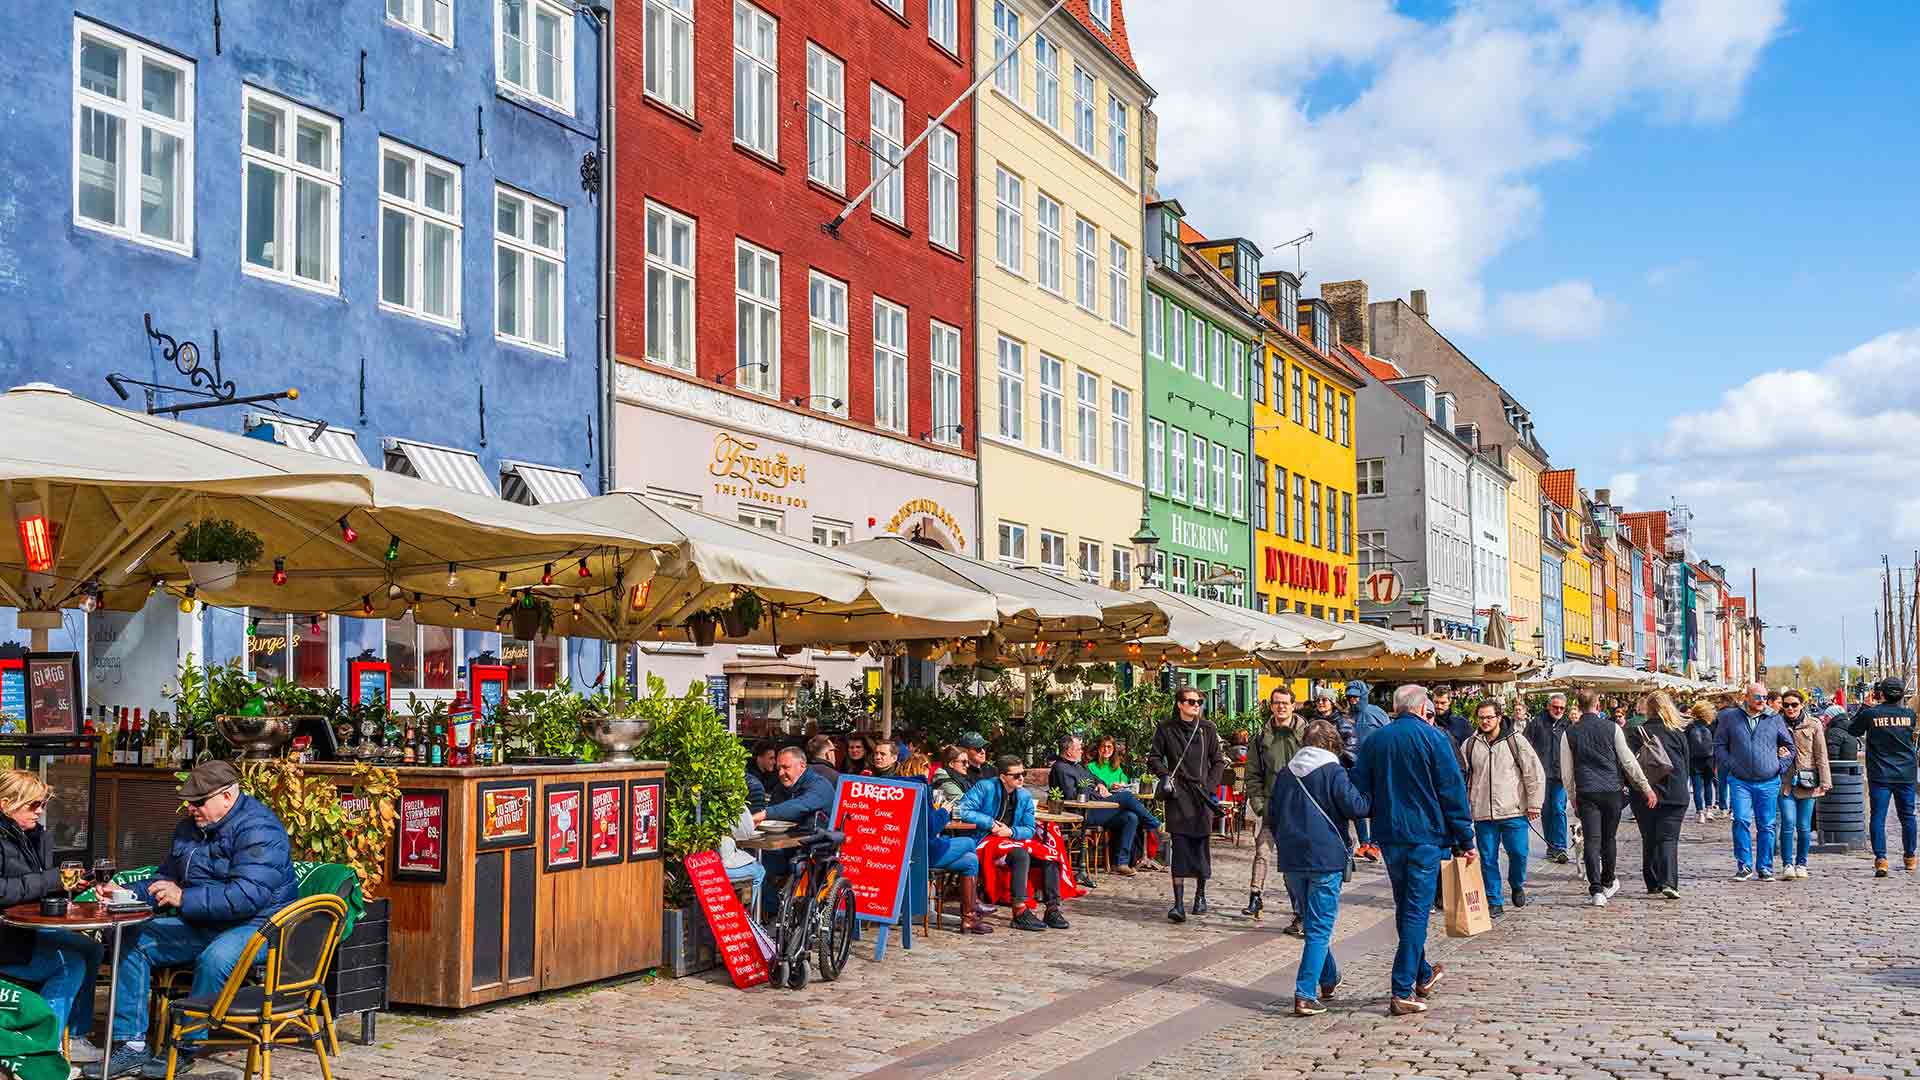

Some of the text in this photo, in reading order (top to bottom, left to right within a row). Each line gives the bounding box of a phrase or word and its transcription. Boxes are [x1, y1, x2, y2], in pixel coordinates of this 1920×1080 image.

[715, 484, 736, 496] THE
[1172, 513, 1229, 555] HEERING
[1265, 546, 1329, 594] NYHAVN
[1367, 573, 1394, 602] 17
[246, 635, 301, 655] Burges
[1873, 717, 1911, 727] THE LAND
[851, 782, 904, 802] BURGERS
[496, 804, 504, 816] TO
[495, 815, 504, 828] OR
[504, 813, 511, 825] TO
